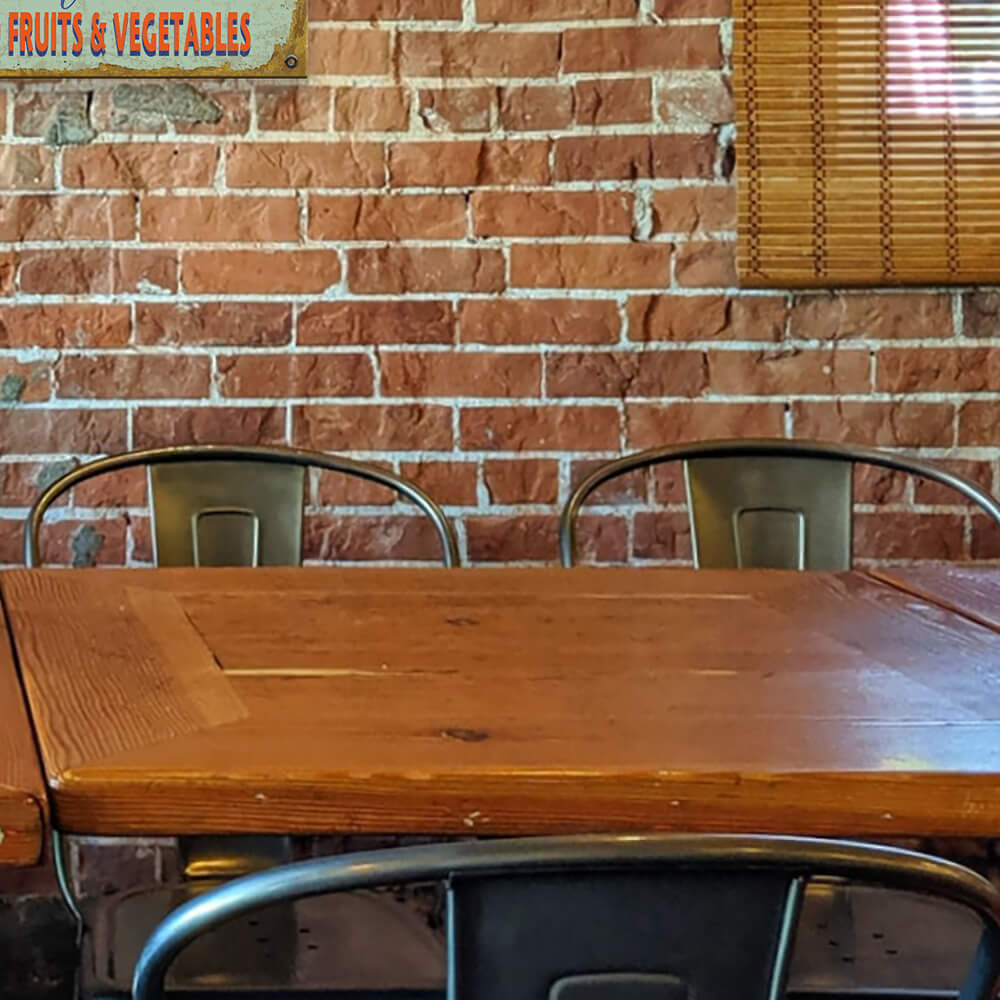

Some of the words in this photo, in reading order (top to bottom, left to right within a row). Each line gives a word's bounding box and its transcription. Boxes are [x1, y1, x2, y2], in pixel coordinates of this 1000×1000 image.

[8, 12, 83, 57] FRUITS
[90, 12, 107, 57] &
[113, 12, 251, 57] VEGETABLES
